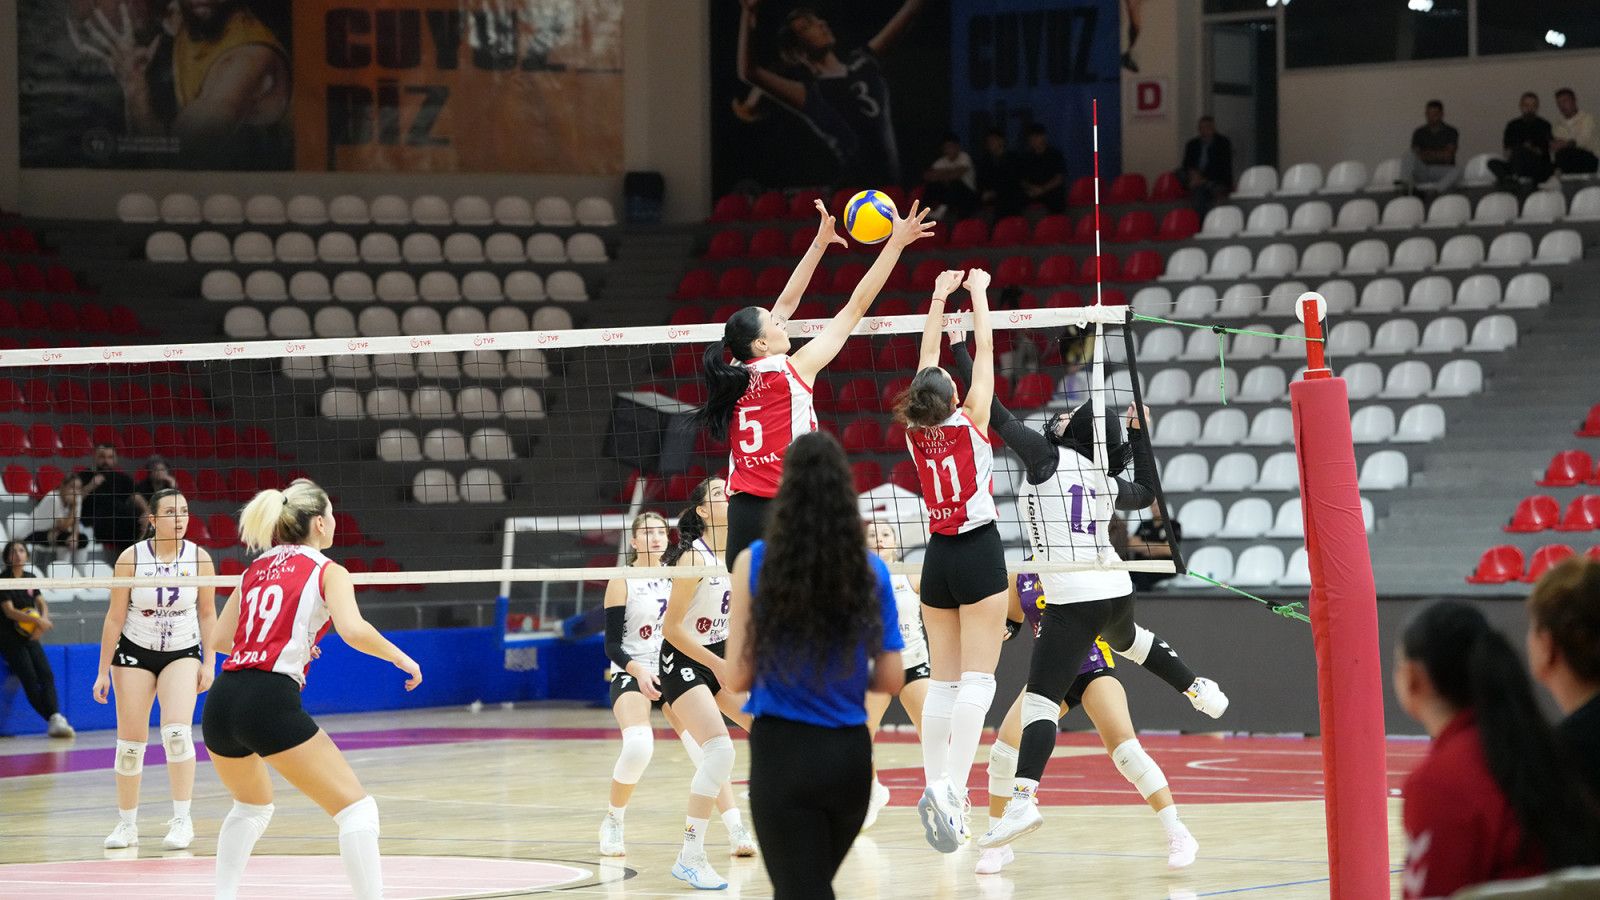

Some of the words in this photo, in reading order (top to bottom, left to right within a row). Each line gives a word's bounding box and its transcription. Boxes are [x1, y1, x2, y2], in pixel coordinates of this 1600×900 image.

[849, 80, 881, 118] 3
[1137, 82, 1162, 111] D
[879, 320, 893, 329] TVF
[949, 317, 962, 326] TVF
[1019, 313, 1033, 322] TVF
[676, 329, 690, 337] TVF
[810, 323, 824, 332] TVF
[419, 339, 432, 347] TVF
[611, 332, 624, 340] TVF
[356, 341, 369, 349] TVF
[739, 406, 763, 454] 5
[925, 455, 962, 503] 11
[156, 587, 179, 607] 17
[721, 590, 731, 615] 8
[246, 584, 284, 643] 19
[656, 599, 668, 620] 7
[229, 650, 267, 665] AZRA
[620, 674, 633, 689] 7
[680, 667, 696, 682] 8
